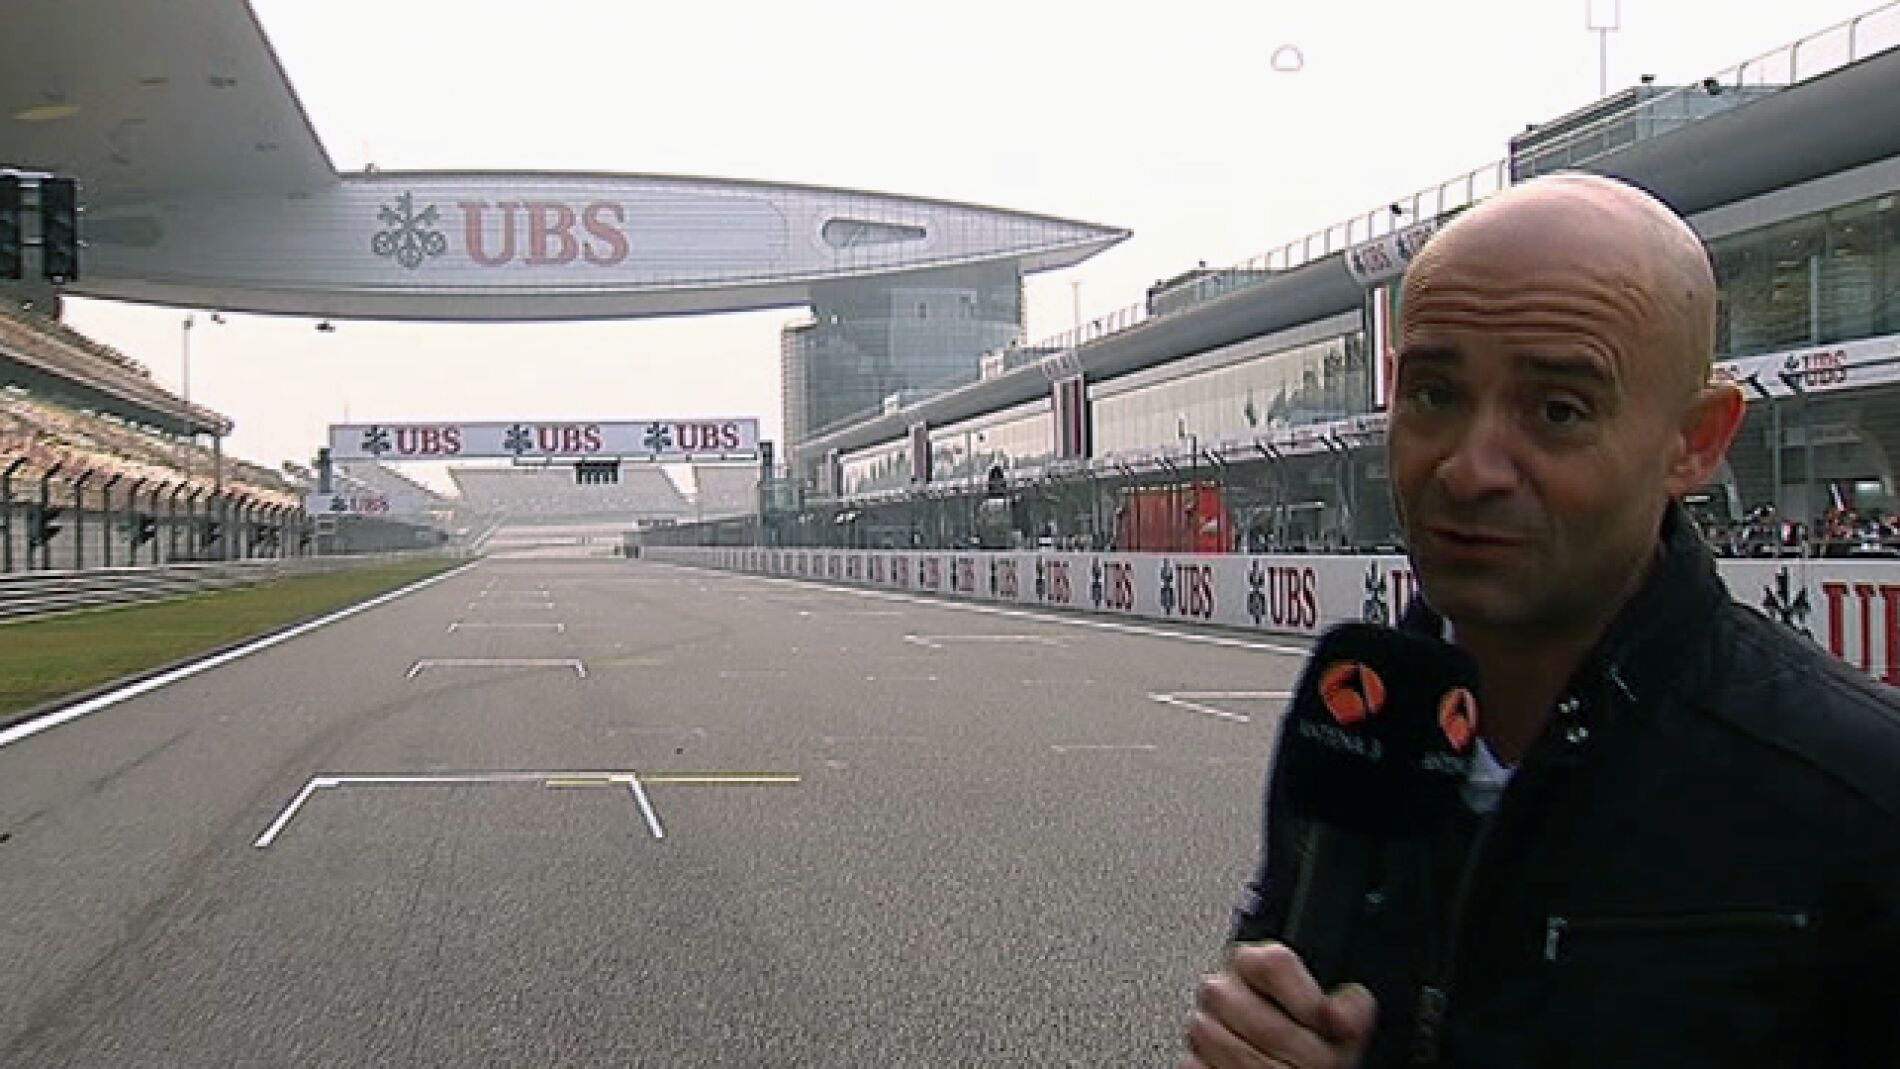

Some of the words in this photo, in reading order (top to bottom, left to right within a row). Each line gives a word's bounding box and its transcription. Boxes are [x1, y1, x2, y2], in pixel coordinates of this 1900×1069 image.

[458, 200, 630, 267] UBS
[395, 427, 462, 455] UBS
[538, 425, 602, 452] UBS
[676, 424, 740, 450] UBS
[1103, 562, 1133, 611] UBS
[1175, 564, 1214, 620] UBS
[1267, 566, 1317, 629] UBS
